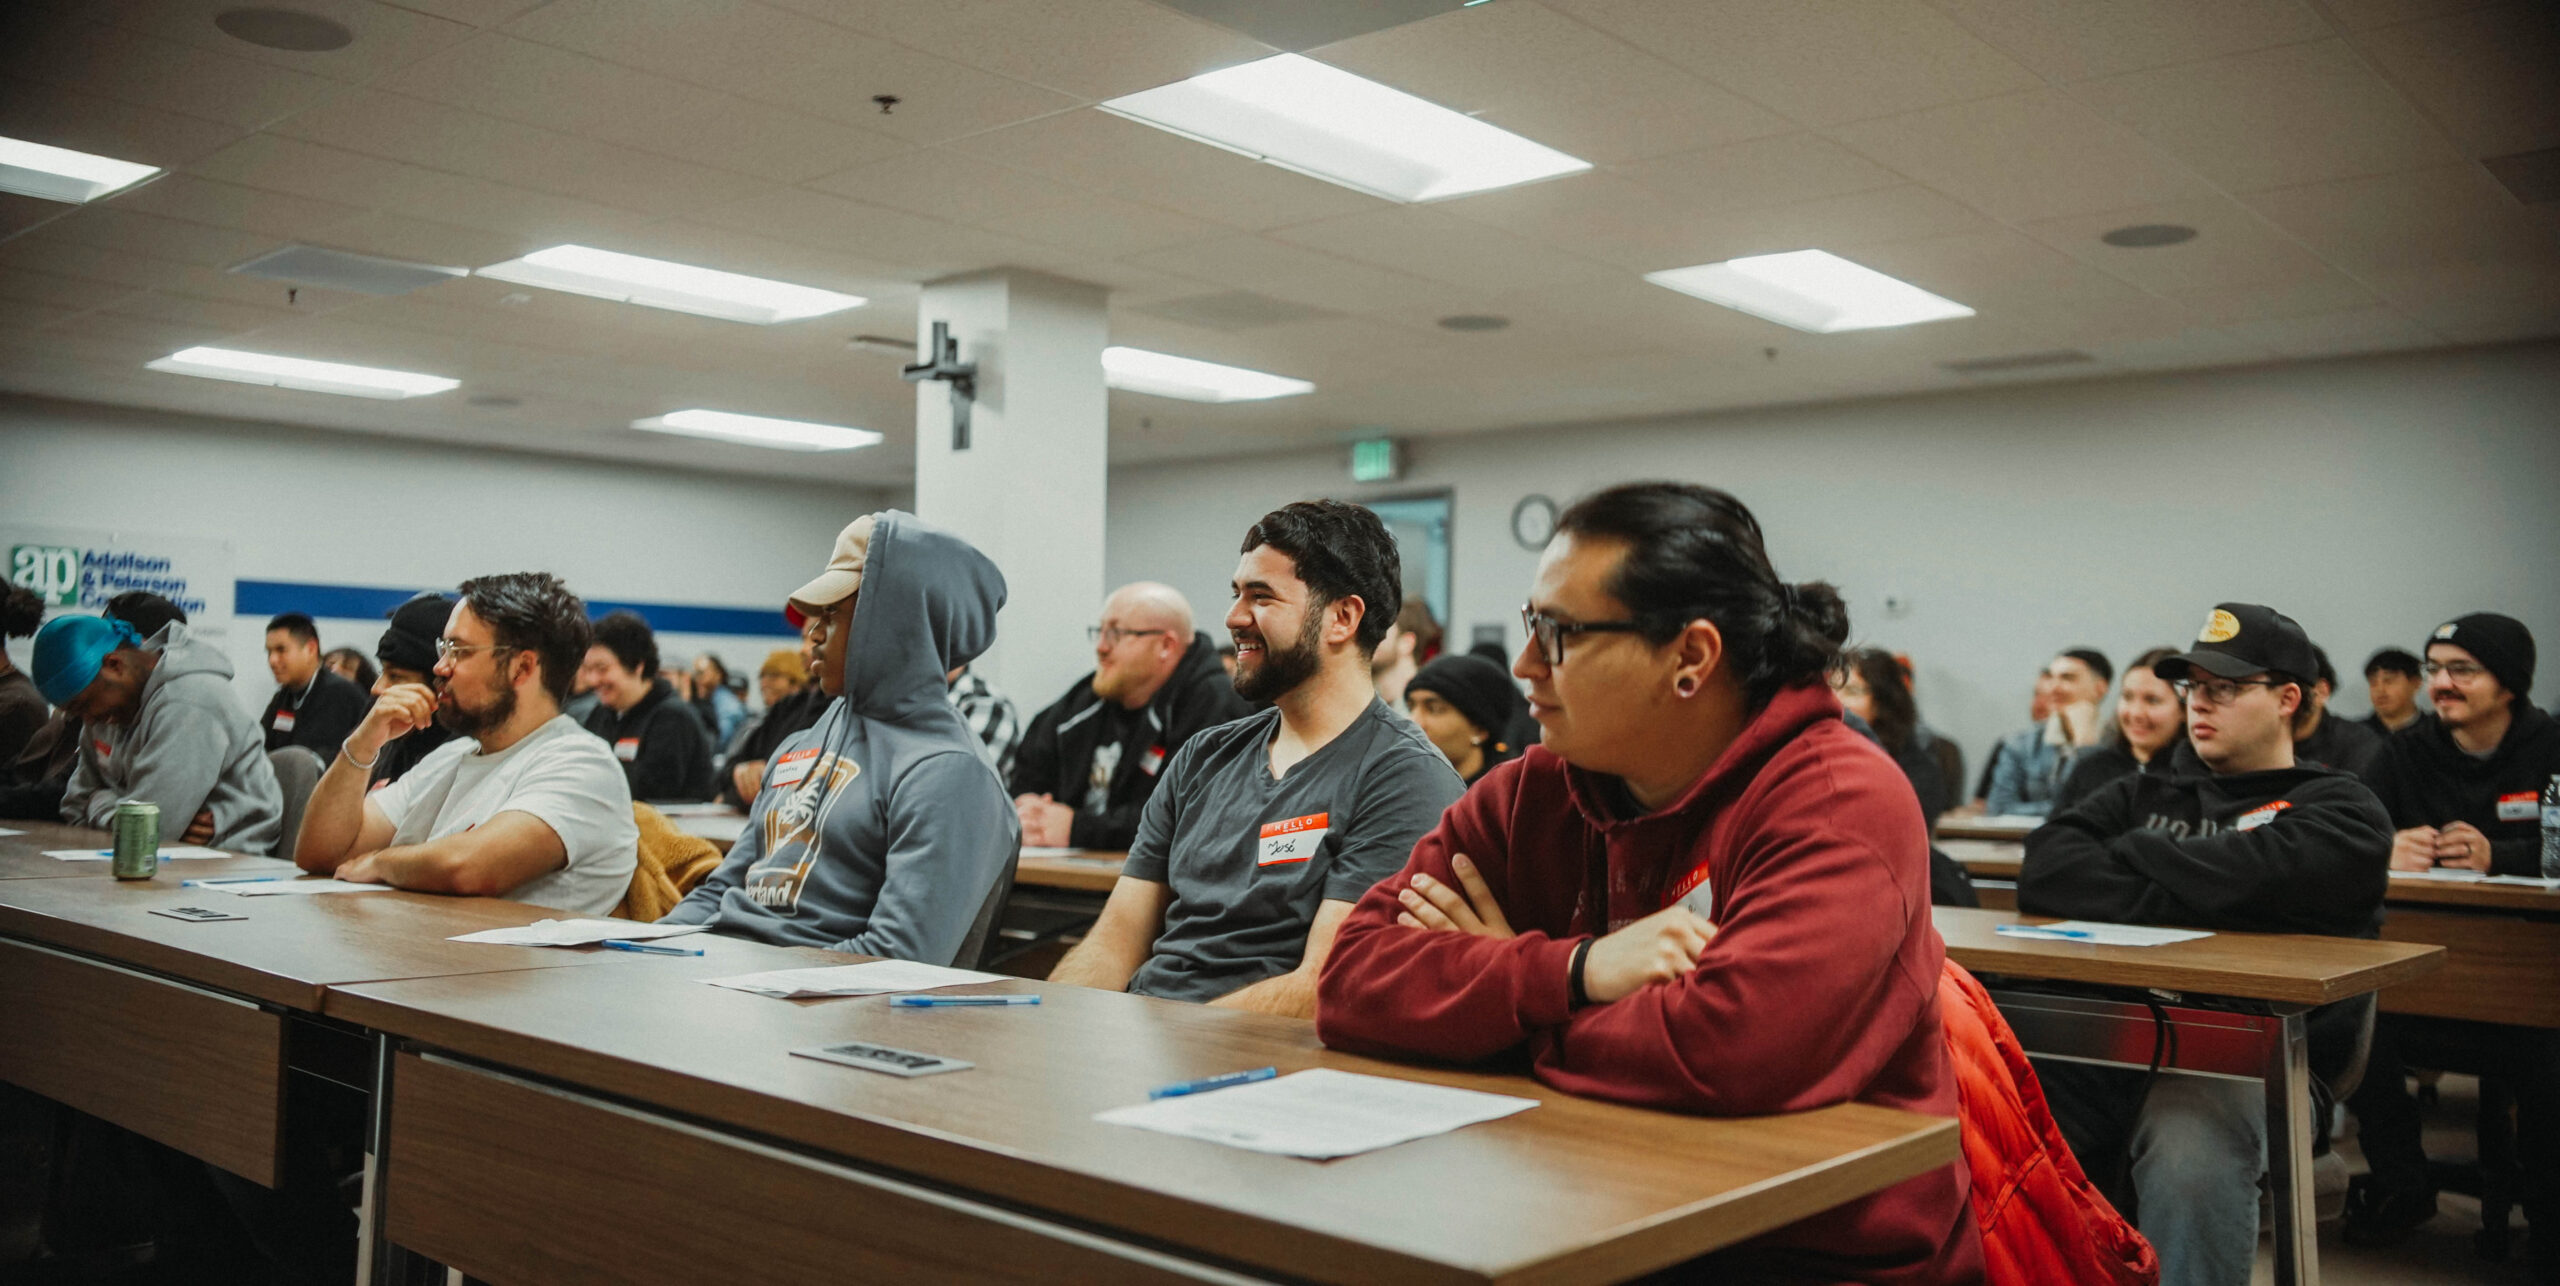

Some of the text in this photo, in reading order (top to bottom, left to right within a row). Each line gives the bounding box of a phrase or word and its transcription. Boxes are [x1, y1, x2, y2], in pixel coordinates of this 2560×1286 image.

[82, 549, 171, 573] Adolfson
[13, 546, 77, 605] ap
[82, 569, 187, 594] & Peterson
[1274, 818, 1313, 831] HELLO
